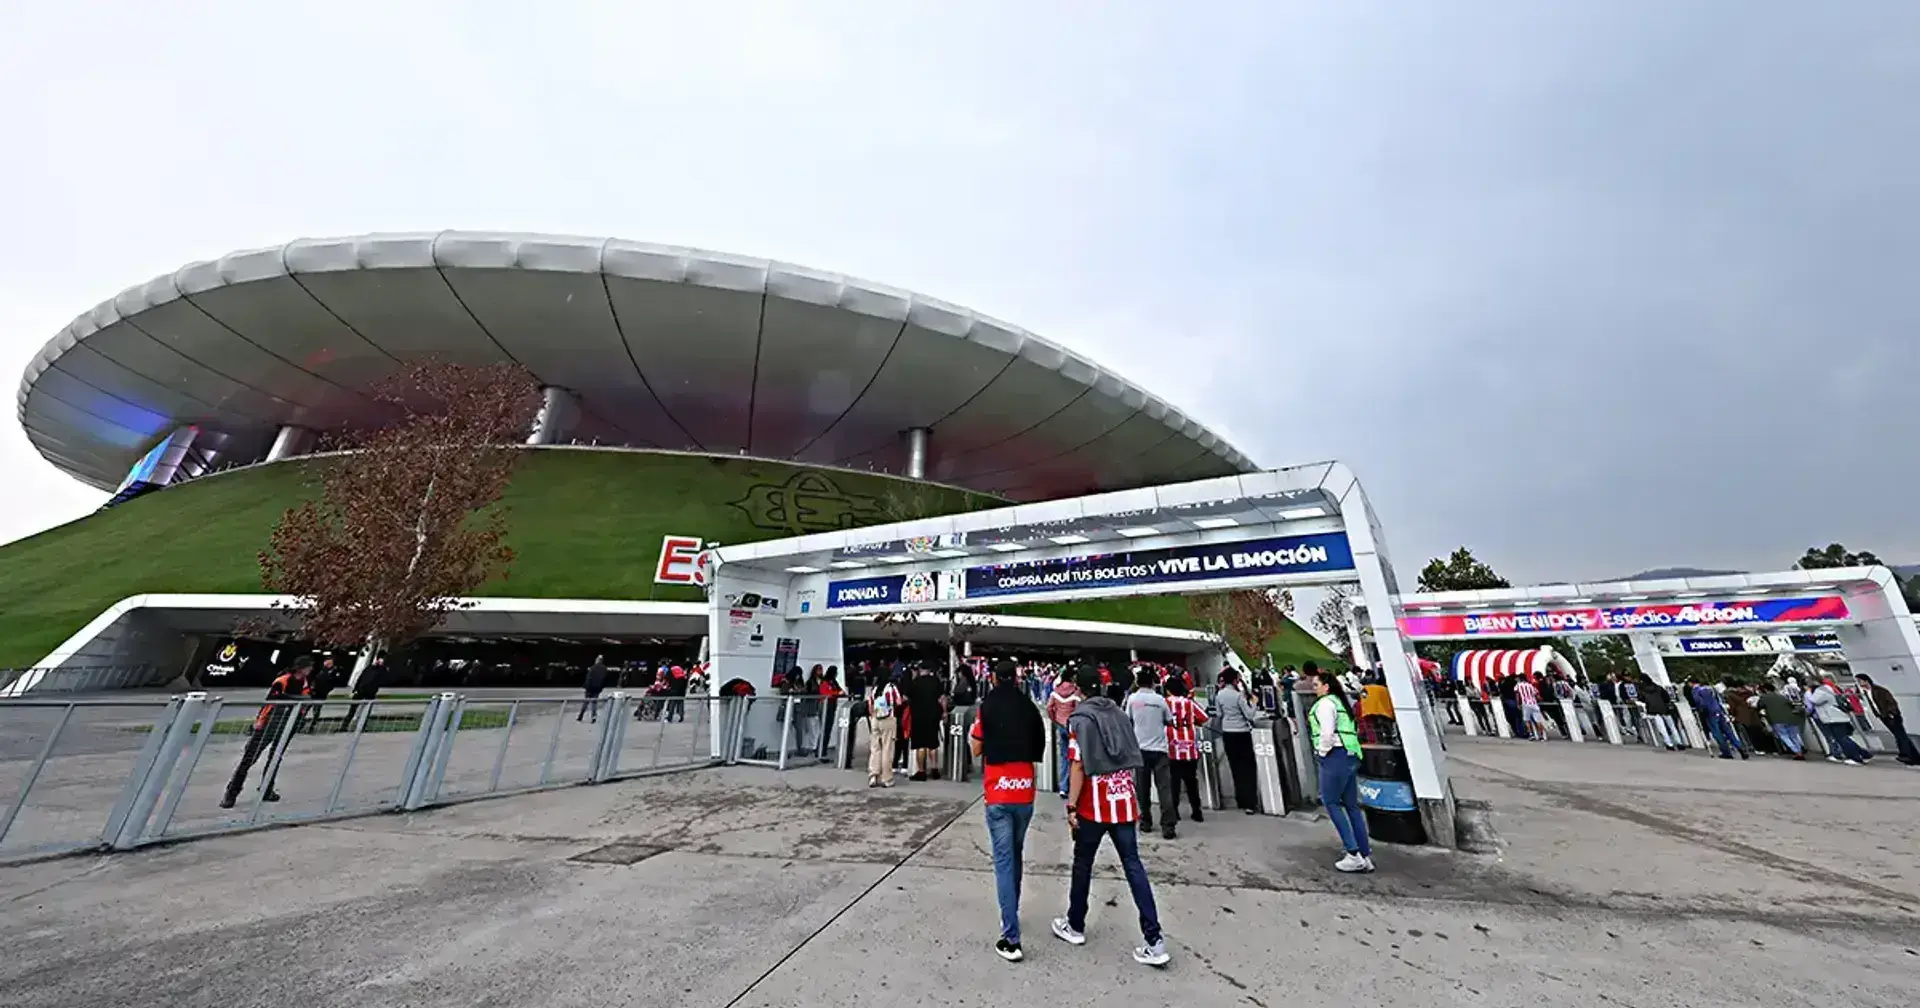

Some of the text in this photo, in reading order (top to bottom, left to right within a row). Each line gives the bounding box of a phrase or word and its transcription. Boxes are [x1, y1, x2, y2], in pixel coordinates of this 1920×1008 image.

[998, 544, 1328, 588] COMPRA AQUÍ TUS BOLETOS Y VIVE LA EMOCIÓN
[837, 585, 888, 602] JORNADA 3
[1463, 612, 1590, 631] BIENVENIDOS
[1601, 610, 1672, 626] Estadio
[1689, 641, 1726, 650] JORNADA
[1255, 744, 1274, 757] 29
